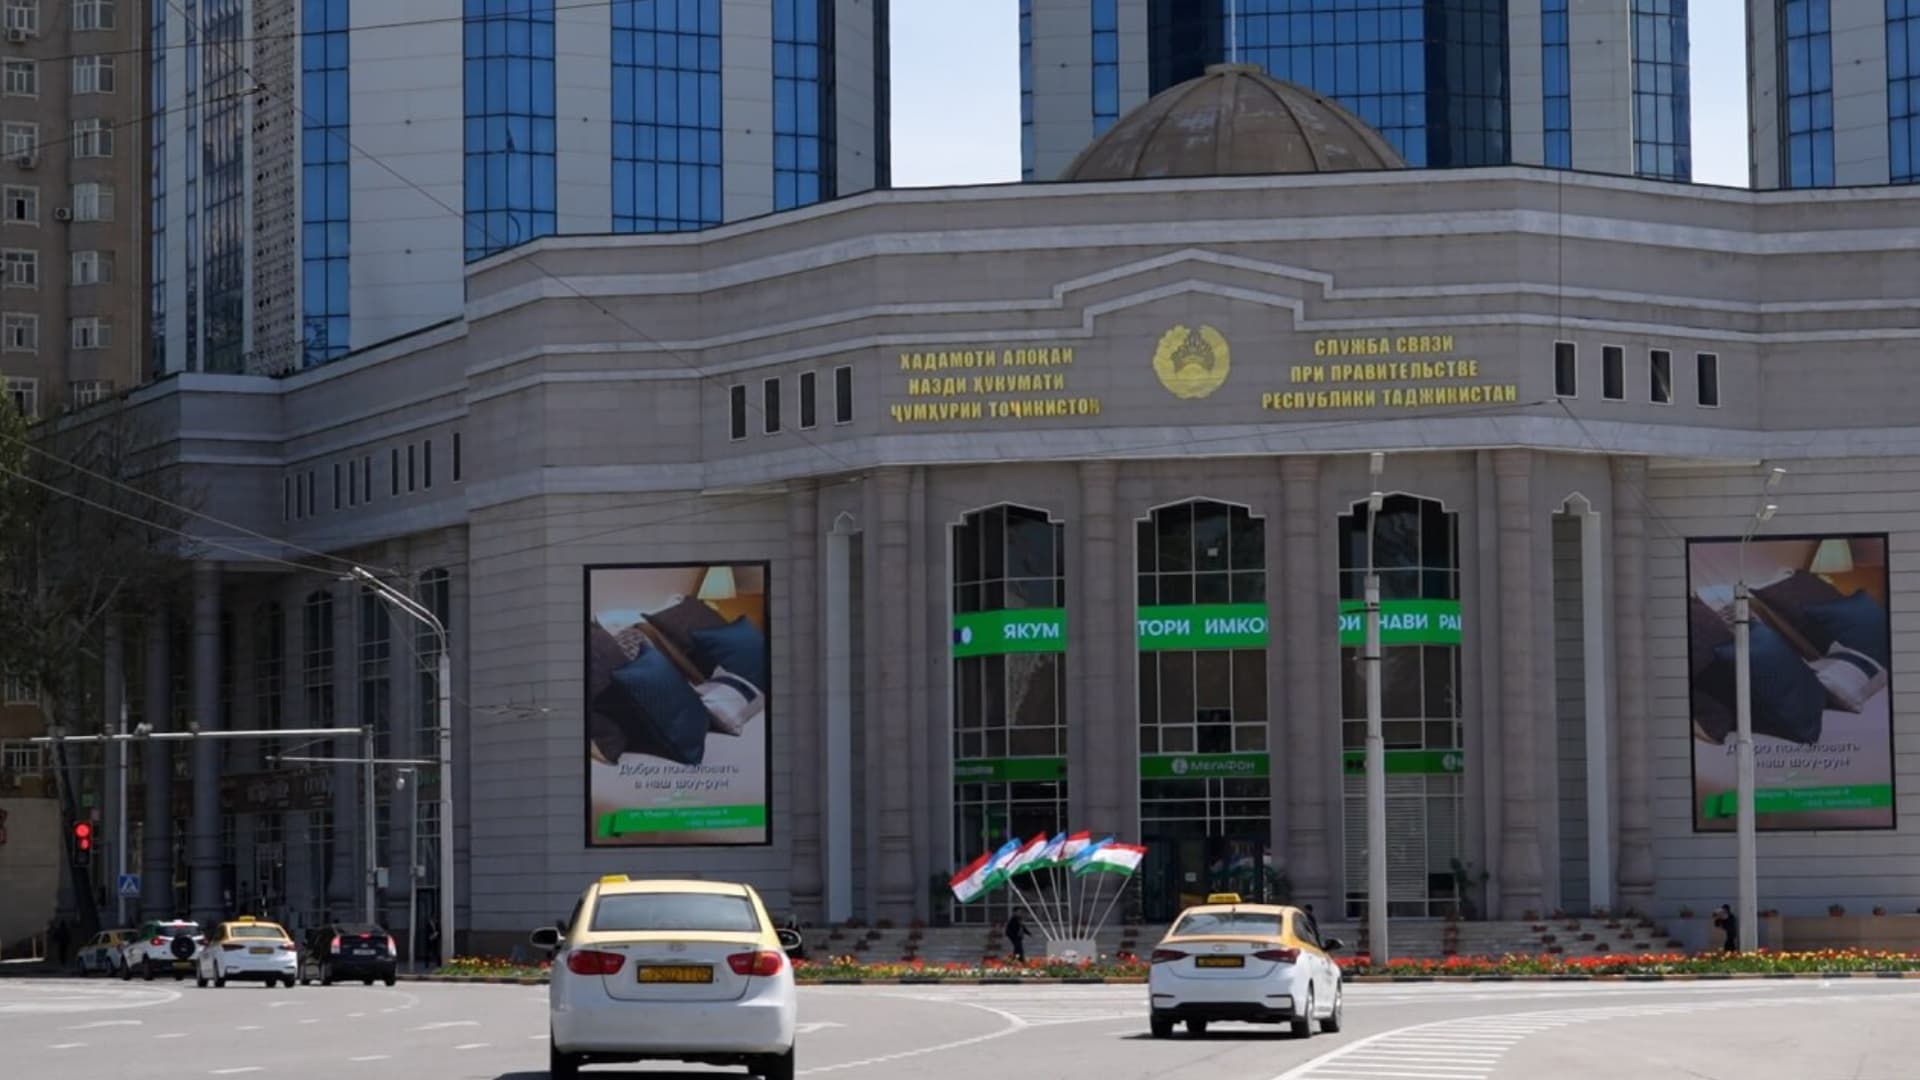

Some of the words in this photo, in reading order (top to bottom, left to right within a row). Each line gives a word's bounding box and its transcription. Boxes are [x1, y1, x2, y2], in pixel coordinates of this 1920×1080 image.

[1314, 338, 1390, 356] СЛУЖБА
[1396, 335, 1454, 353] СВЯЗИ
[901, 351, 996, 371] ХАДАМОТИ
[1291, 365, 1324, 383] ПРИ
[1331, 360, 1479, 381] ПРАВИТЕЛЬСТВЕ
[909, 376, 967, 396] НАЗДИ
[1262, 390, 1376, 409] РЕСПУБЛИКИ
[1383, 385, 1517, 407] ТАДЖИКИСТАН
[1003, 622, 1059, 639] ЯКУМ
[1205, 617, 1269, 634] ИМКО
[1379, 613, 1428, 630] НАВИ
